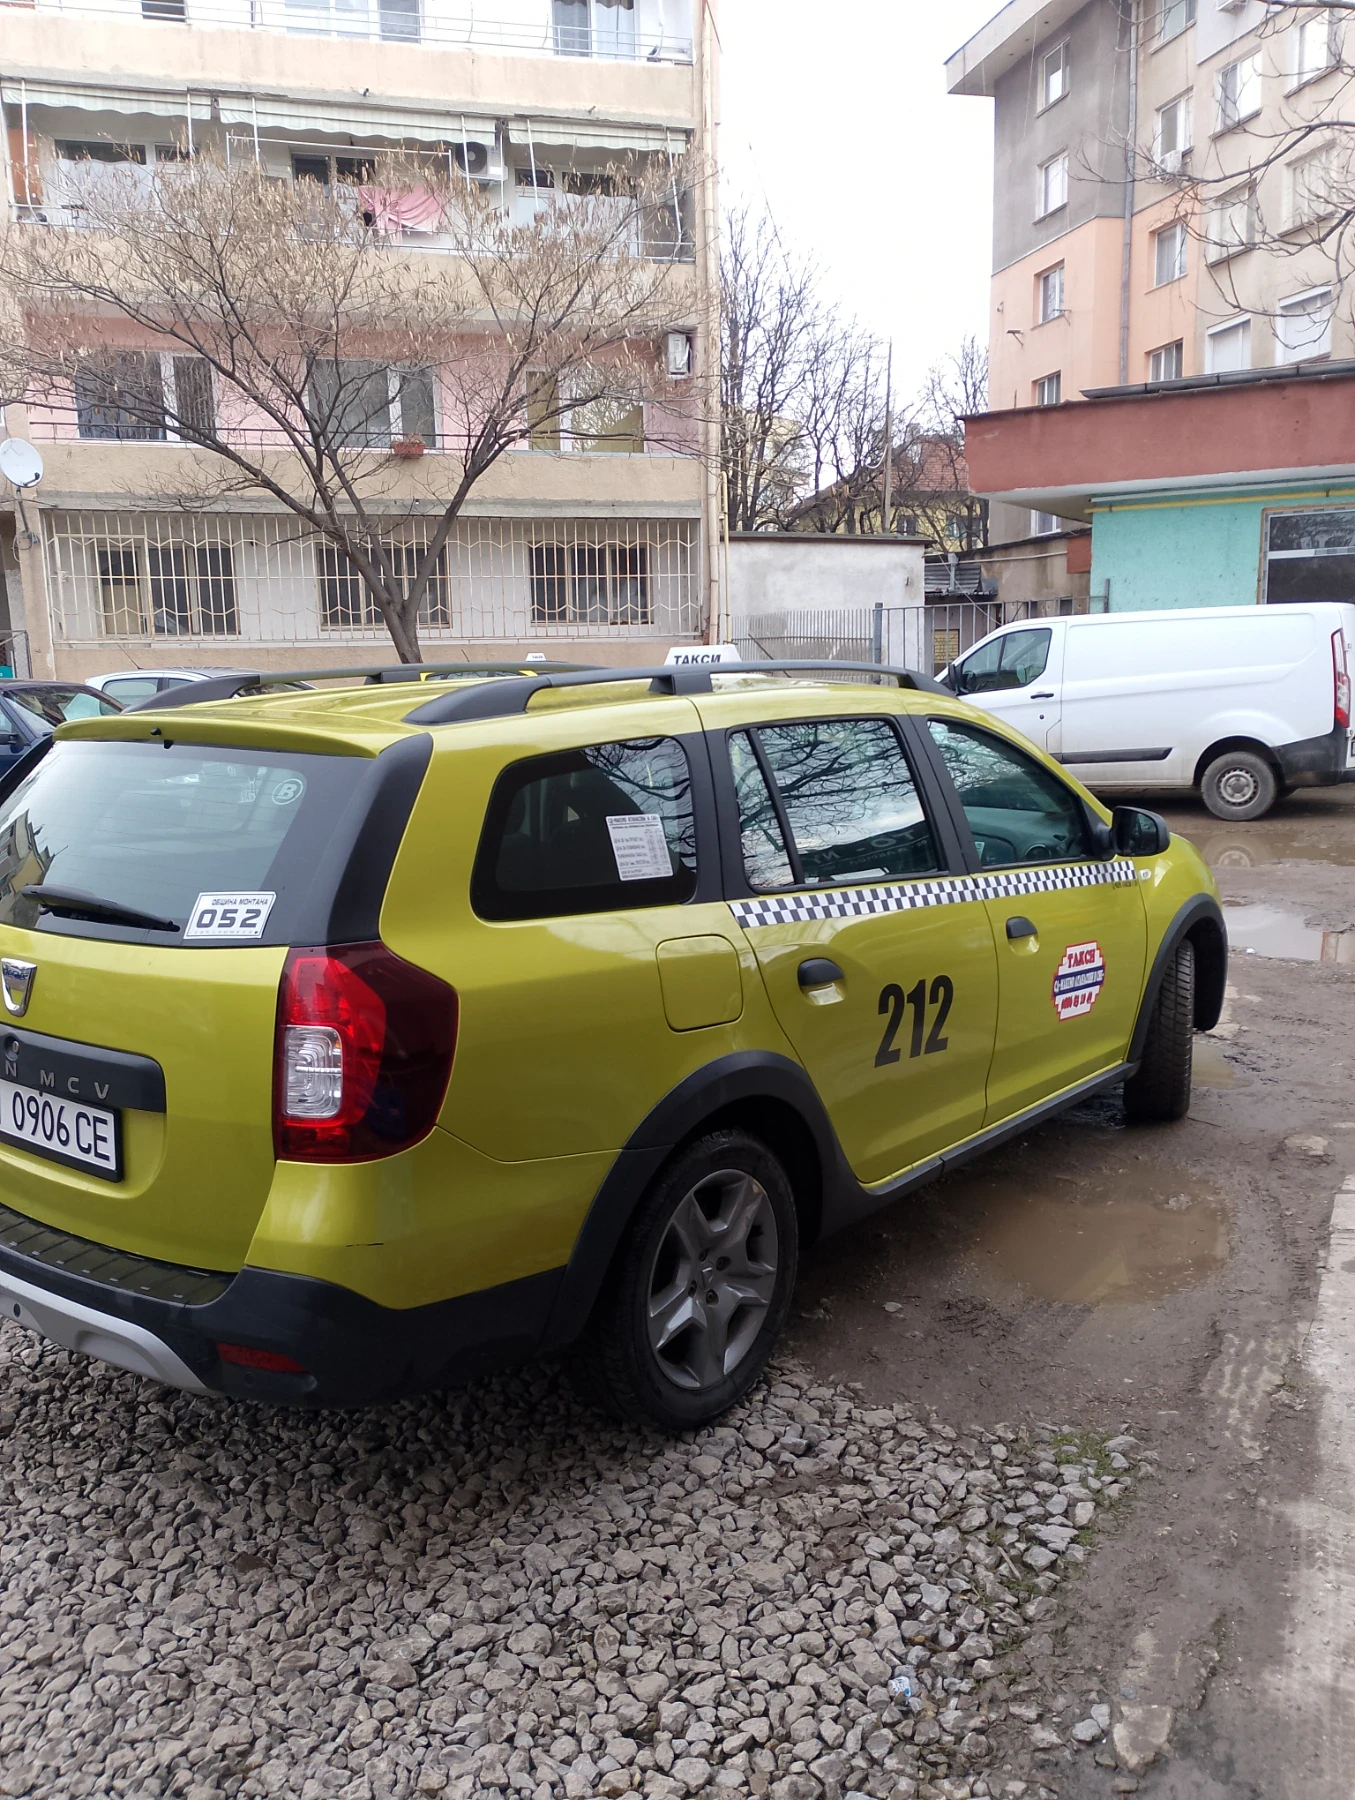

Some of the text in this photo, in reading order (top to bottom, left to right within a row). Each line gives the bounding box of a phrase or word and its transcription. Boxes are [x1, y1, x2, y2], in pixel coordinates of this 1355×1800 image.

[674, 654, 722, 665] ТАКСИ
[238, 898, 269, 906] МОНТАНА
[196, 908, 262, 929] 052
[1067, 948, 1097, 968] ТАКСИ
[874, 974, 954, 1069] 212
